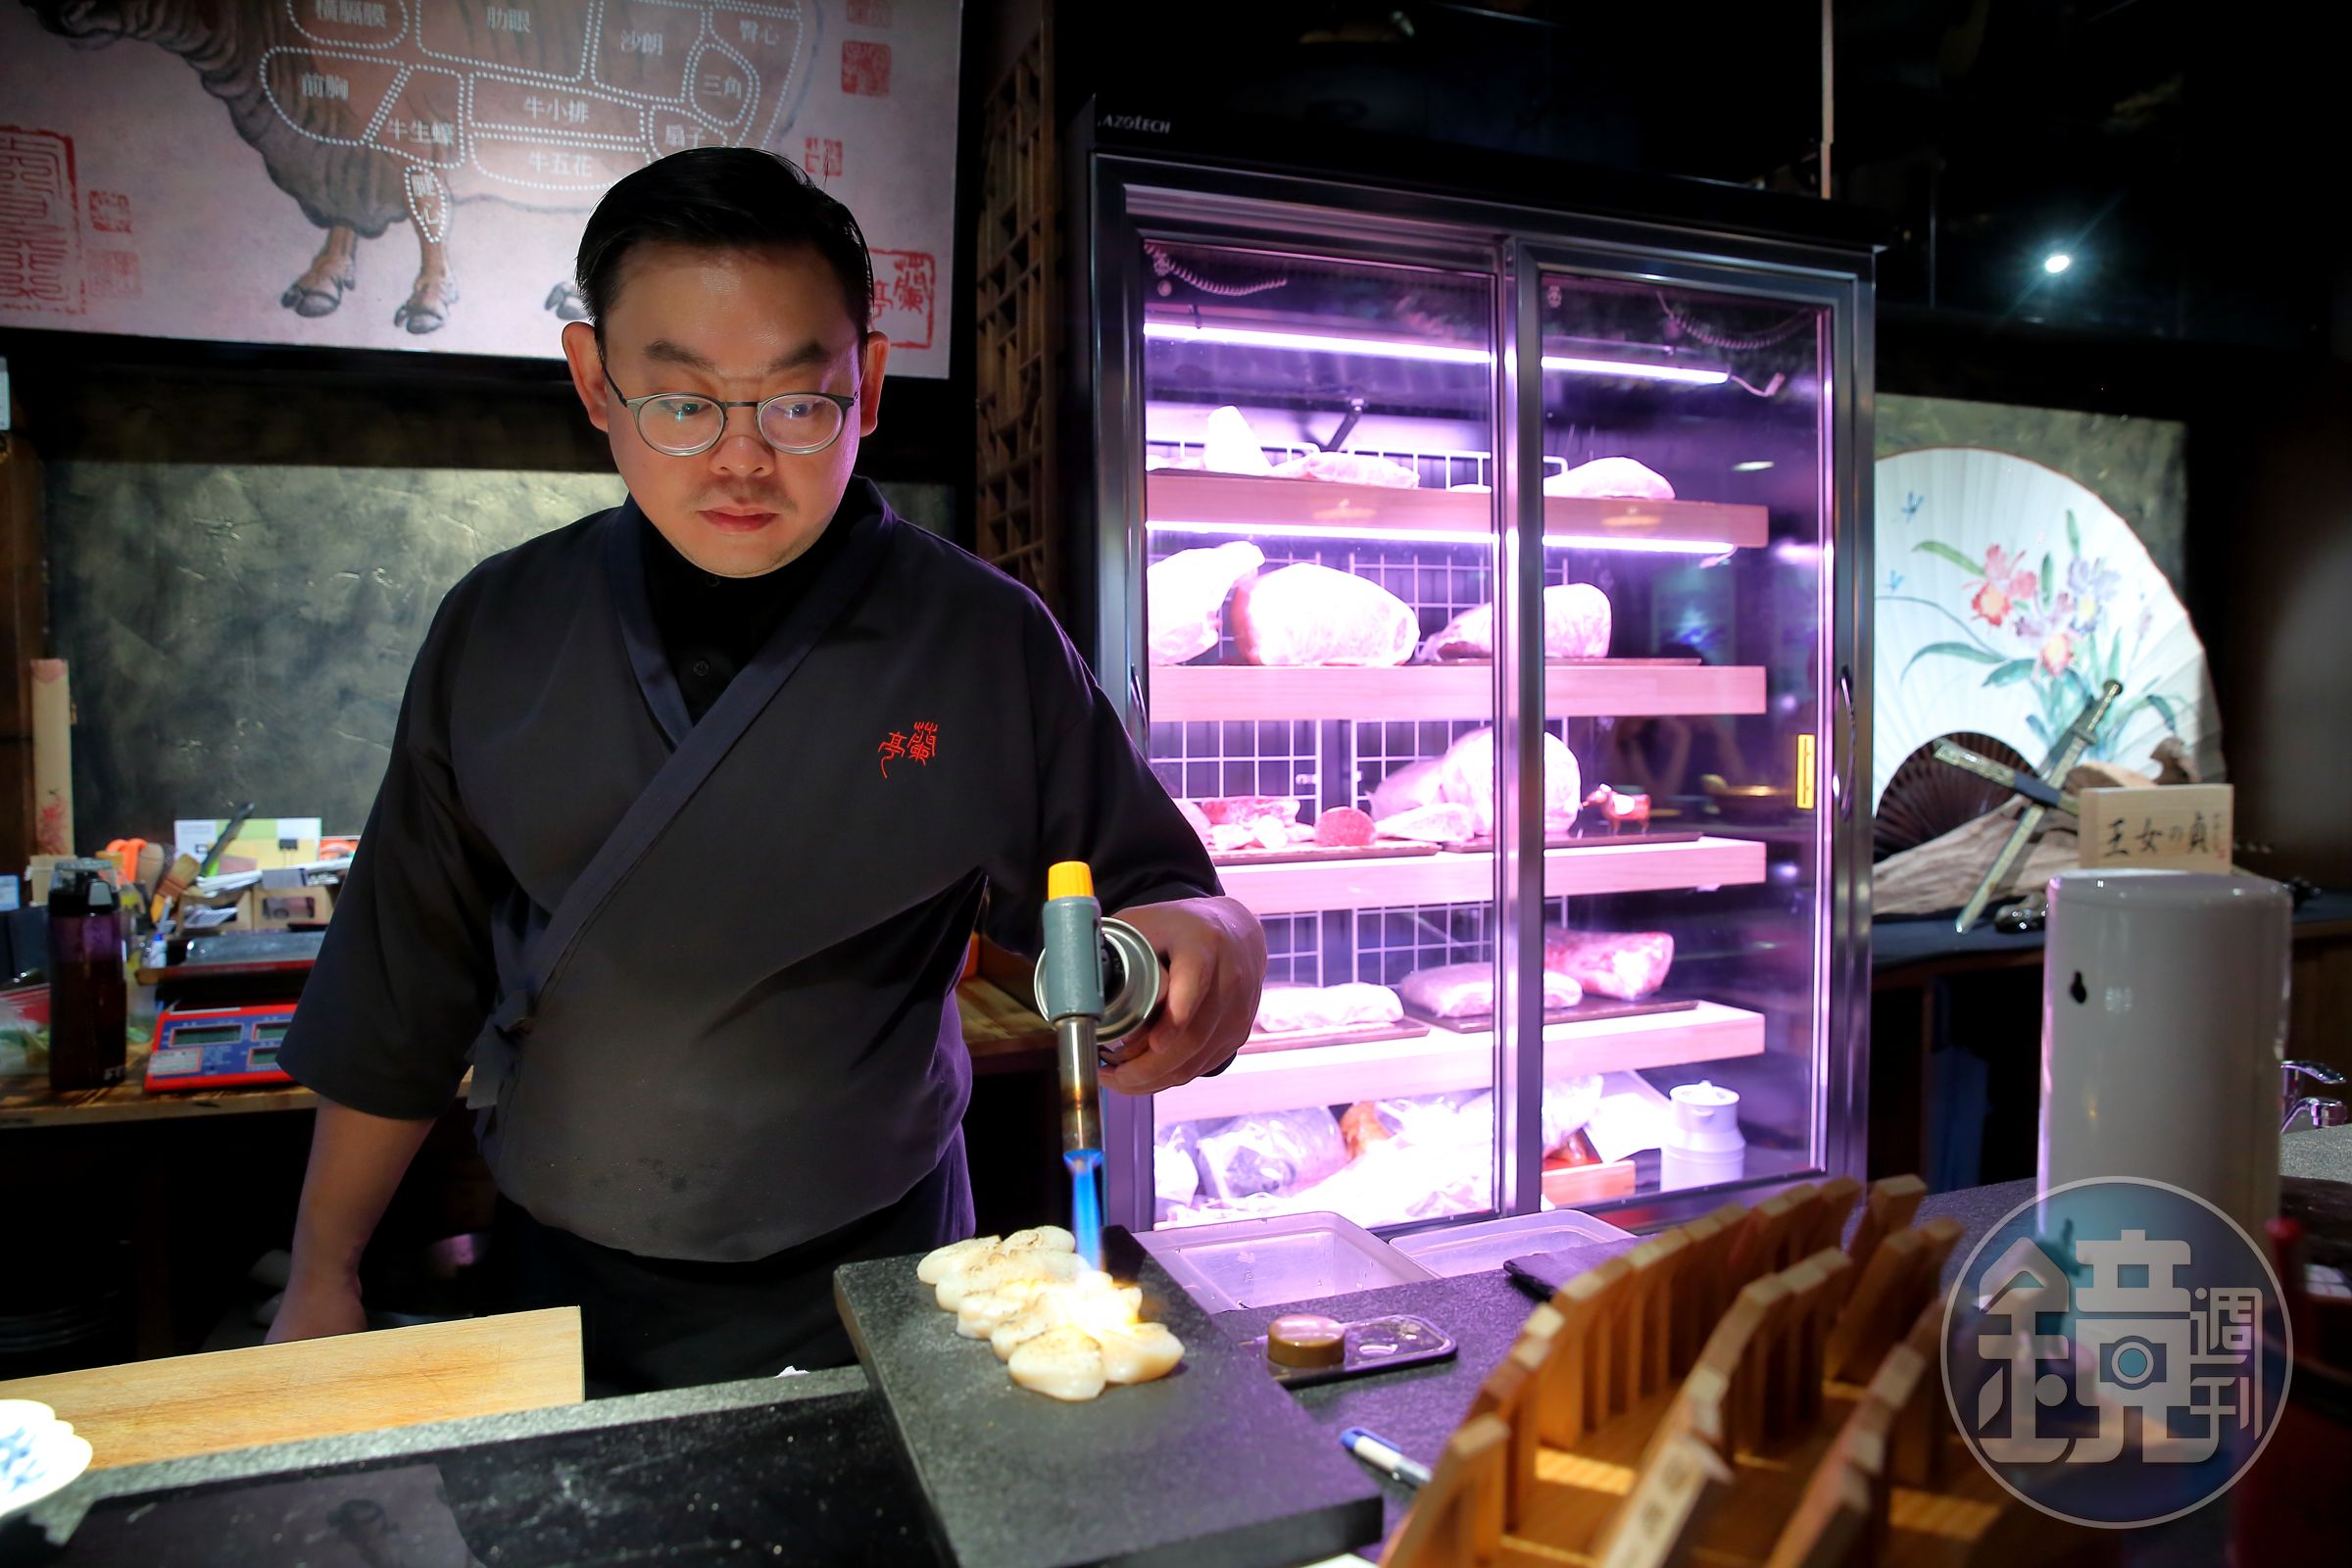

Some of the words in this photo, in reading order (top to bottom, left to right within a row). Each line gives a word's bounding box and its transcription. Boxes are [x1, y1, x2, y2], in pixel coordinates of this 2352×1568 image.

[620, 29, 663, 56] 沙朗
[703, 75, 742, 99] 三角
[523, 95, 590, 123] 牛小排
[528, 151, 594, 177] 牛五花
